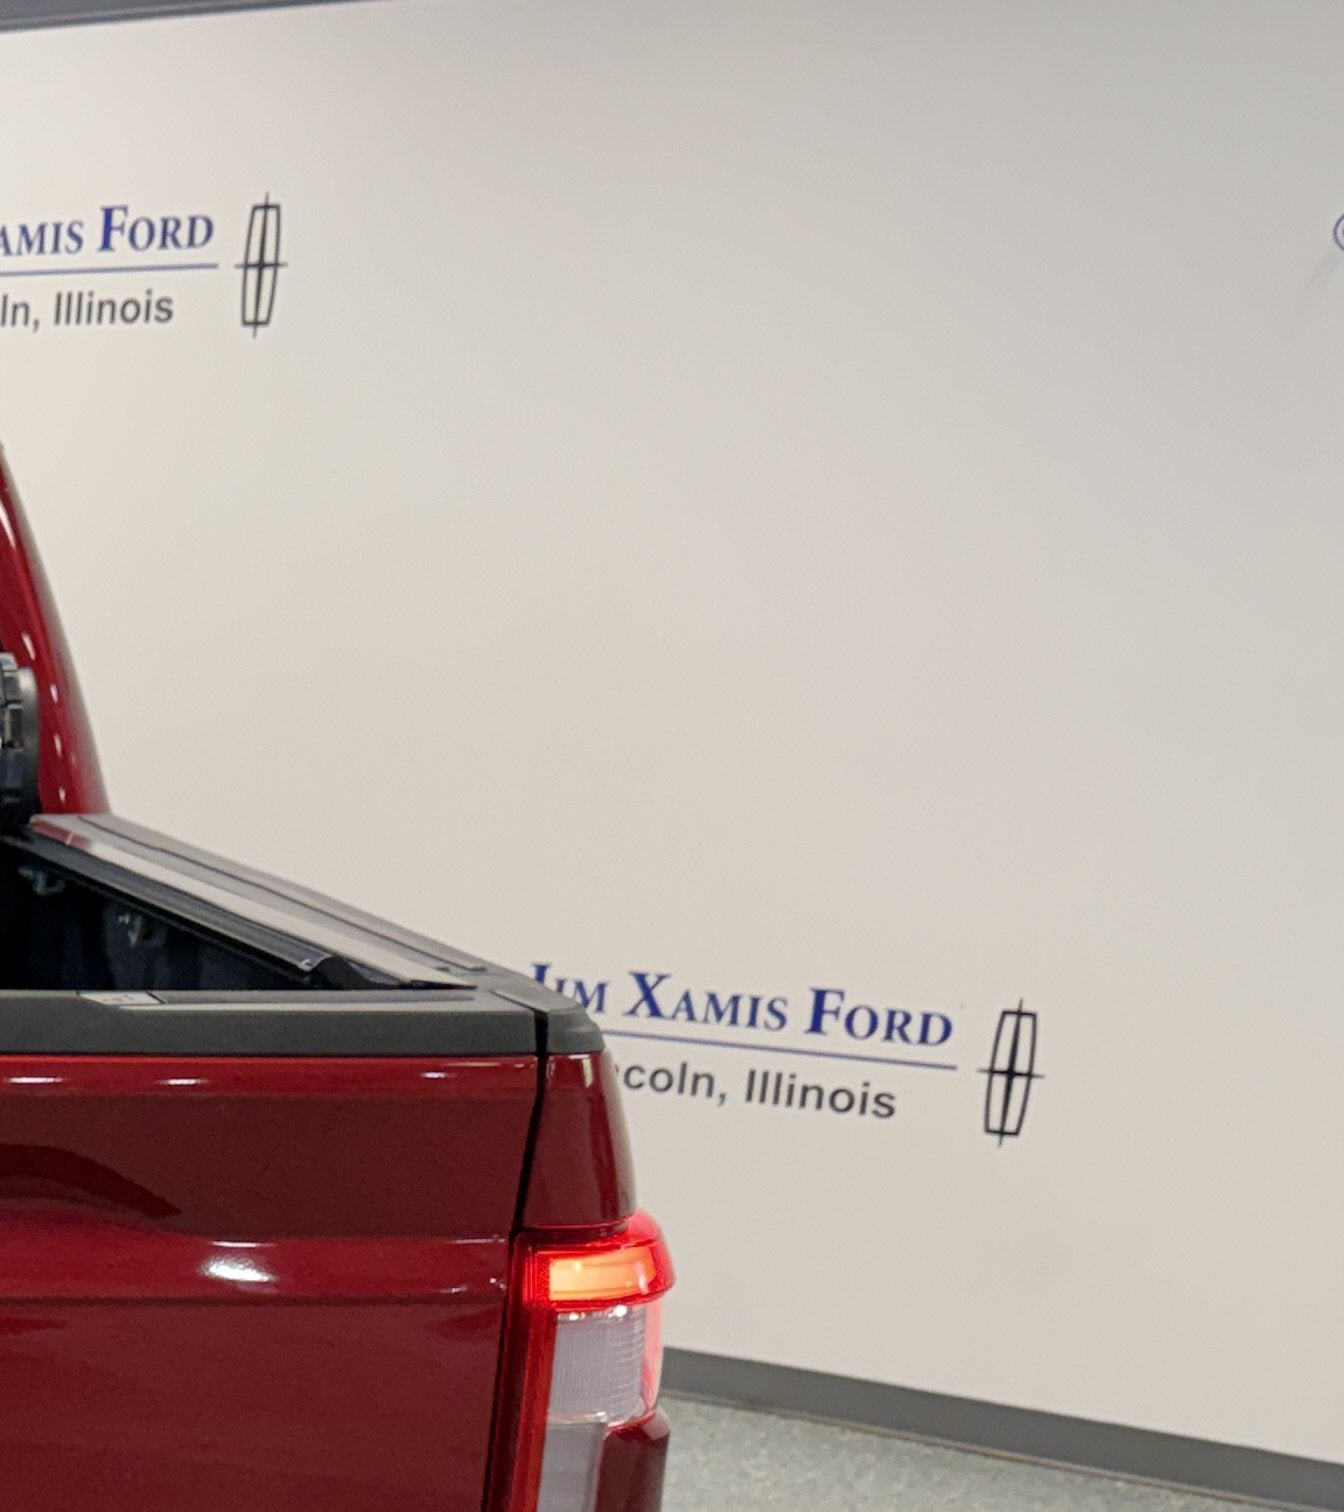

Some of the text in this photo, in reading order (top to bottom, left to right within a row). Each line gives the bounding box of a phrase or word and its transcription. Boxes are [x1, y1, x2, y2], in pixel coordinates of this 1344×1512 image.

[97, 204, 214, 253] FORD
[53, 289, 174, 327] Illinois
[624, 970, 789, 1032] XAMIS
[804, 985, 955, 1047] FORD
[744, 1067, 897, 1119] Illinois
